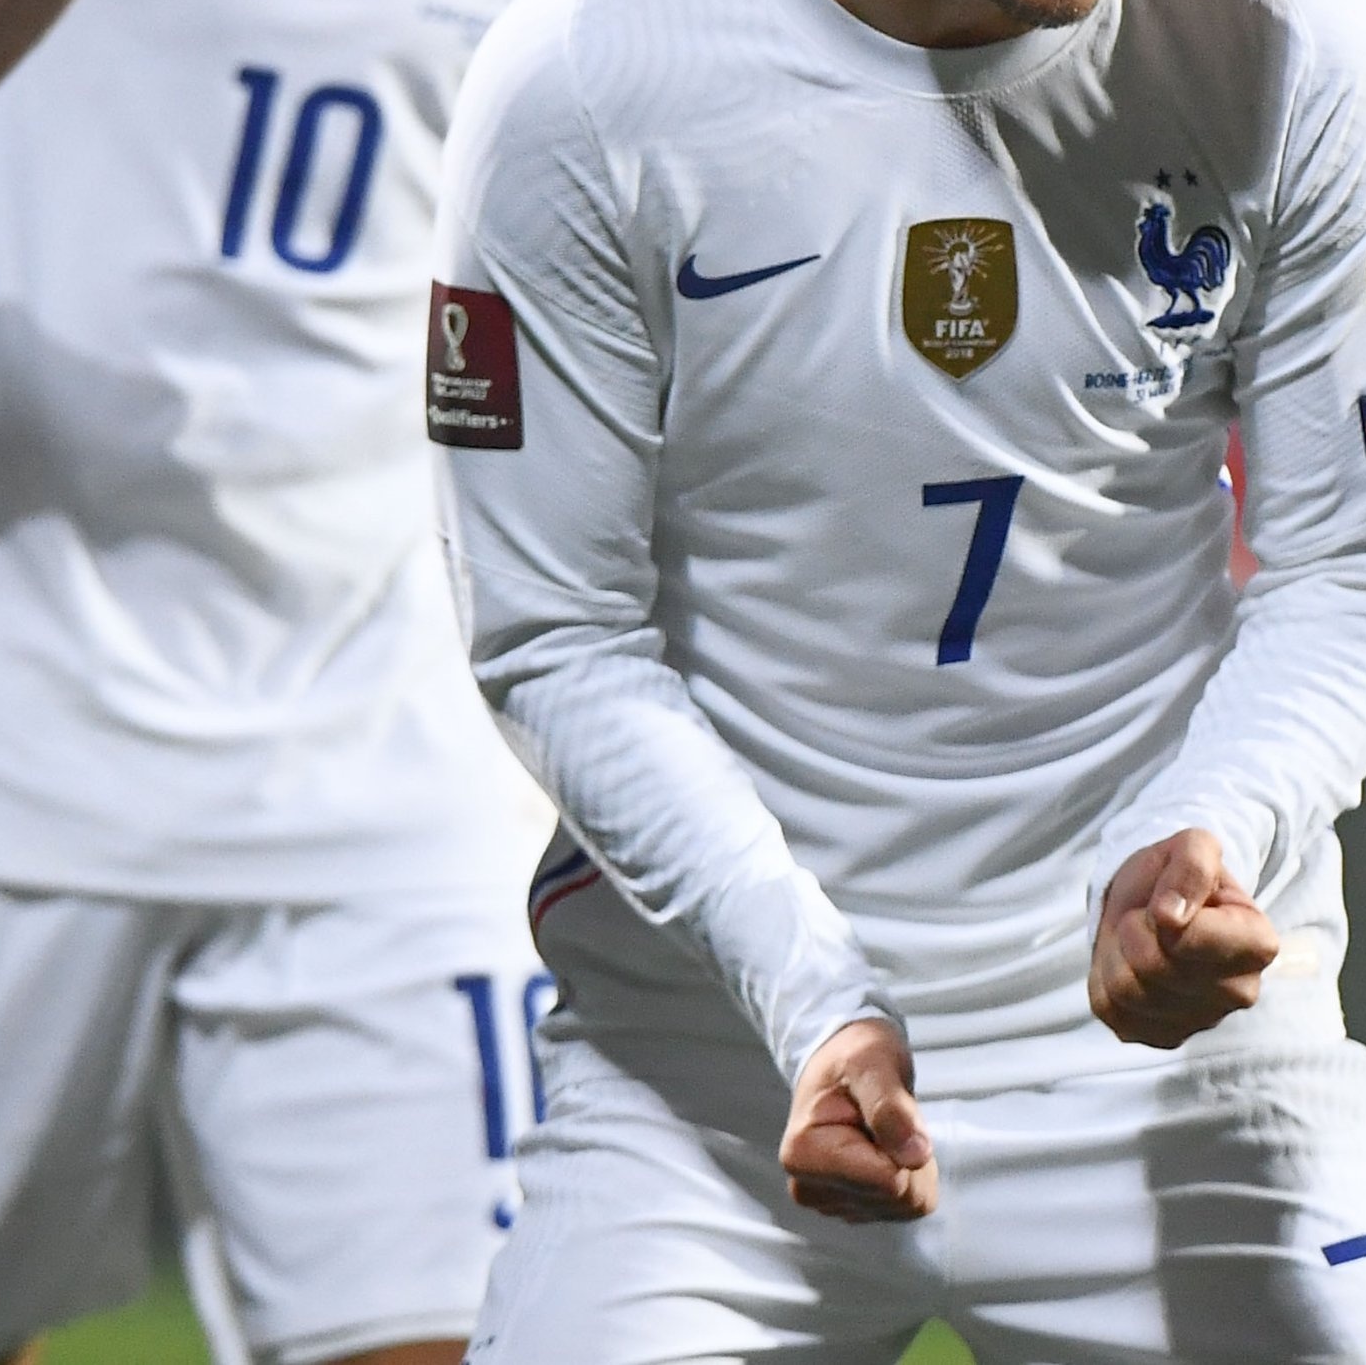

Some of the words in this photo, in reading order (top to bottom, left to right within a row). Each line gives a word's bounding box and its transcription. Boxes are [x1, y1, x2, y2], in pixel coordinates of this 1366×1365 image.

[221, 67, 383, 274] 10
[935, 319, 985, 338] FIFA
[922, 475, 1025, 666] 7
